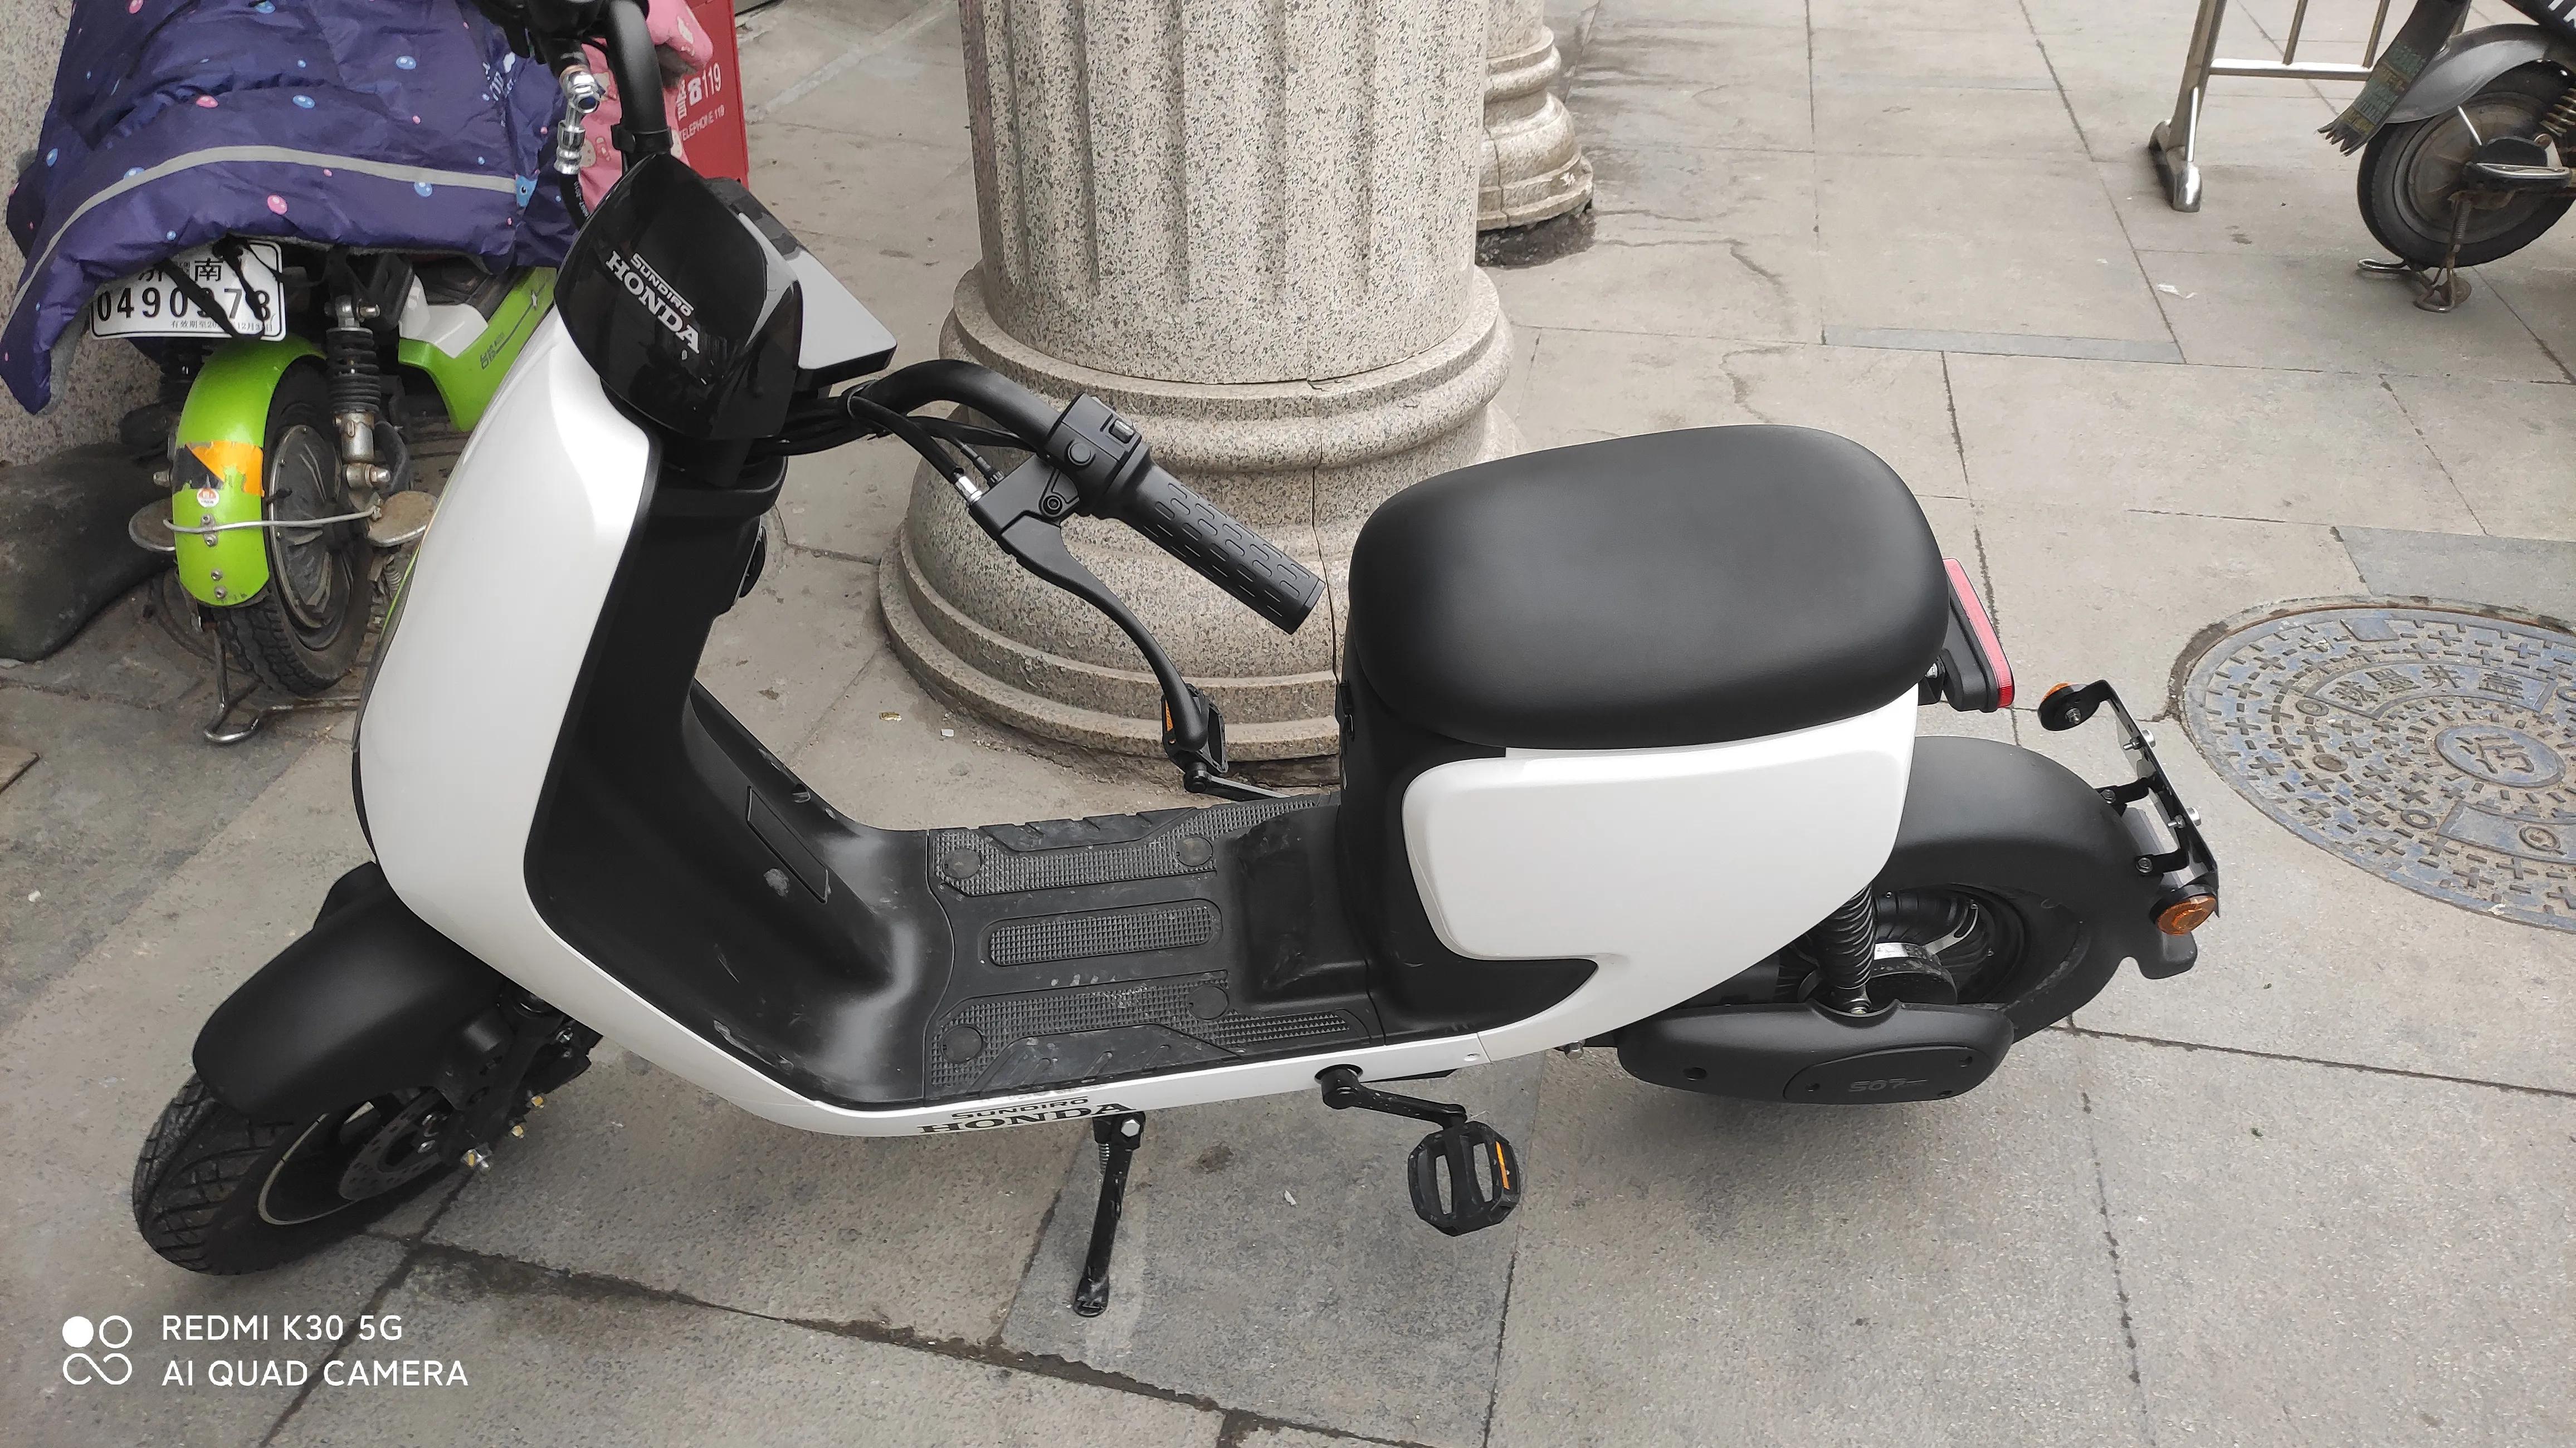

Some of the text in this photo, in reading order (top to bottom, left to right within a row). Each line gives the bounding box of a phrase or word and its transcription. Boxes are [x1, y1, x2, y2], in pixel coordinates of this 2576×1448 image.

[702, 62, 721, 98] 119
[606, 250, 700, 354] HONDA
[629, 252, 695, 316] SUNDIRO
[918, 1103, 1136, 1133] HONDA
[952, 1096, 1089, 1119] SUNDIRO
